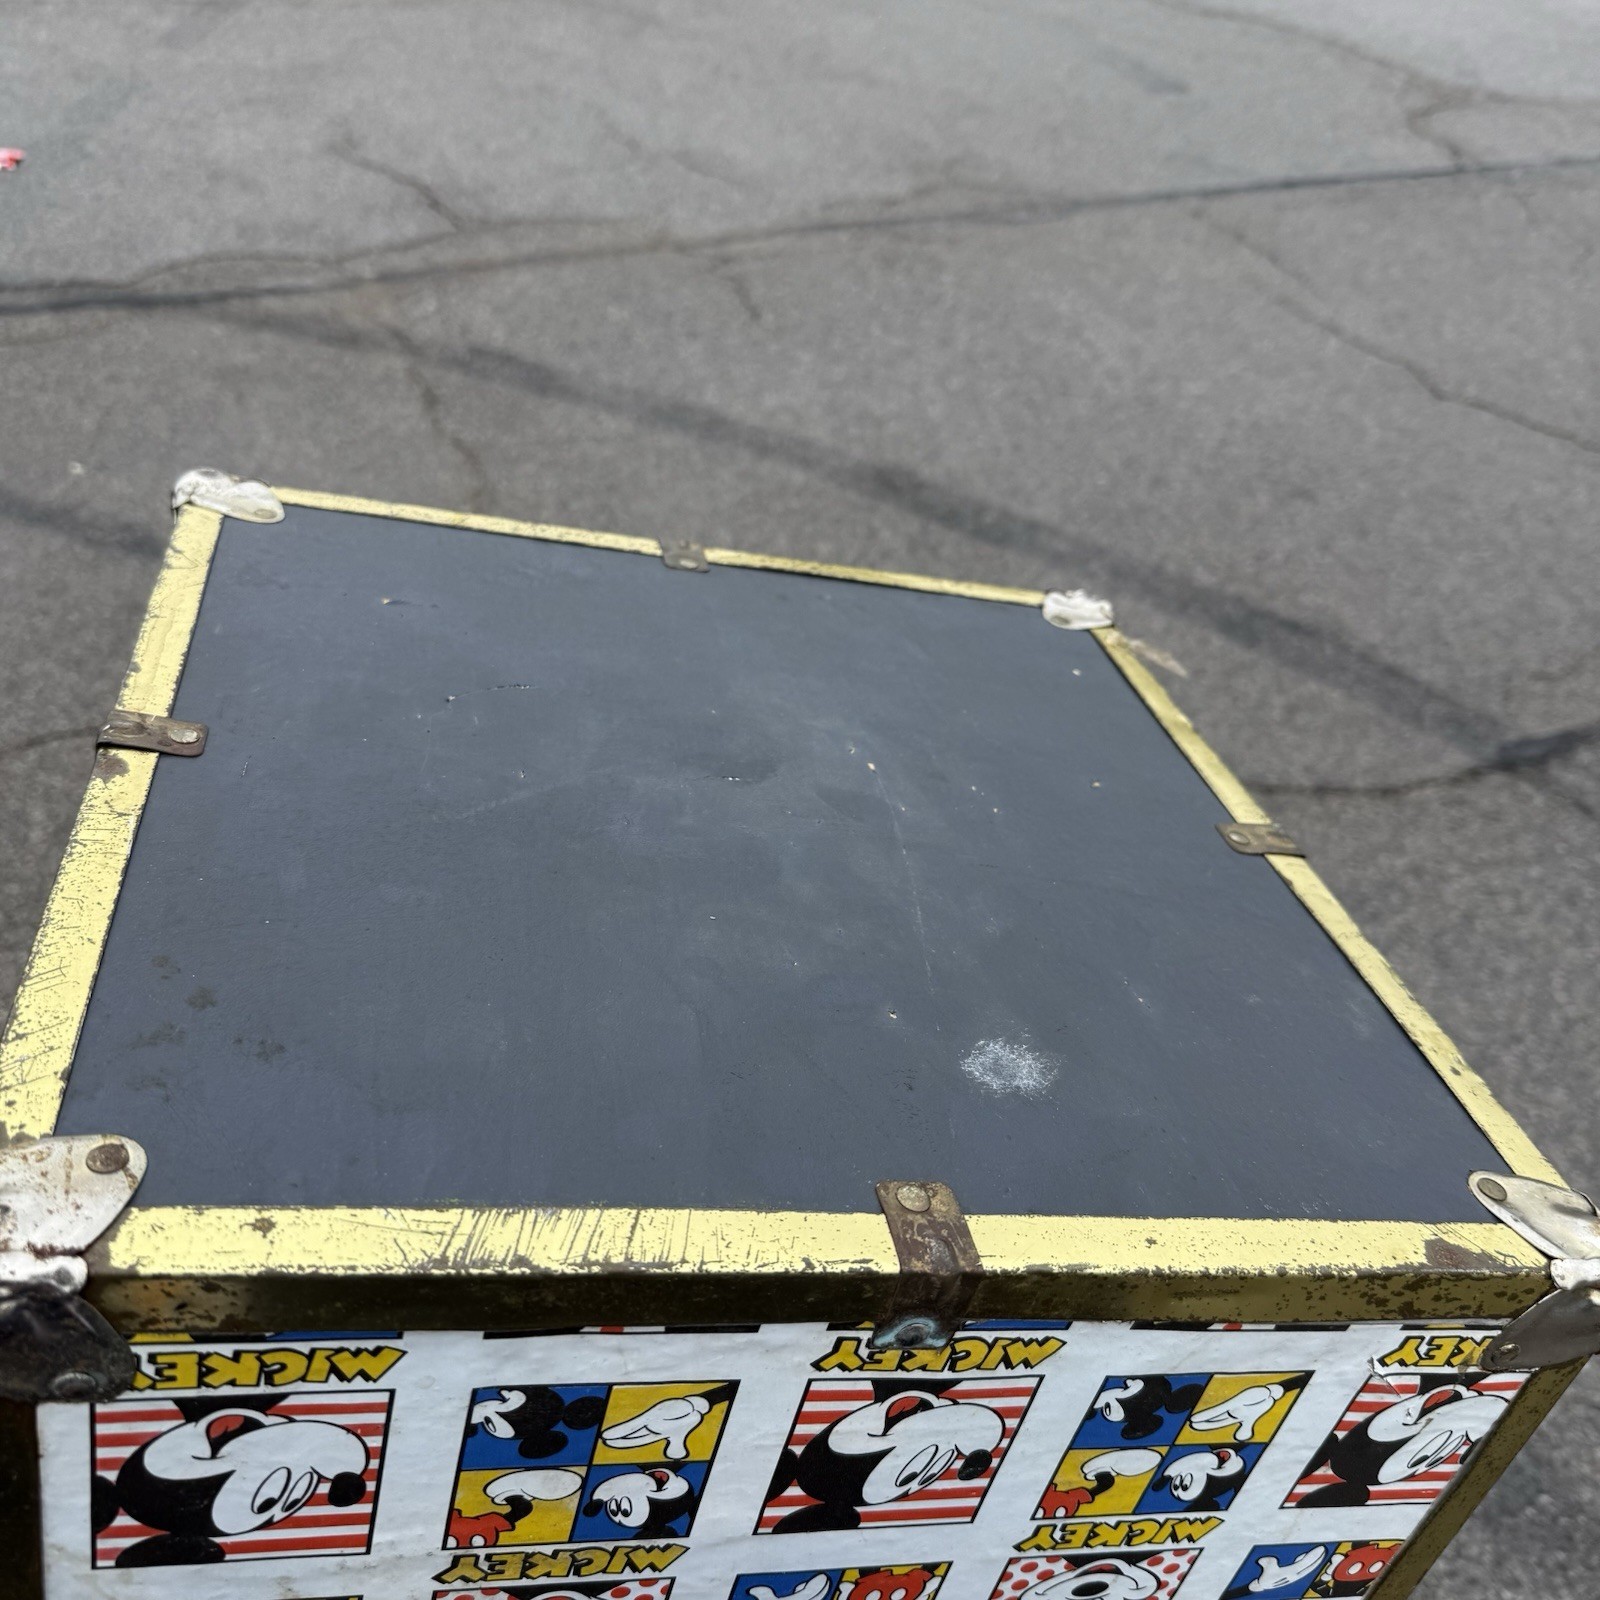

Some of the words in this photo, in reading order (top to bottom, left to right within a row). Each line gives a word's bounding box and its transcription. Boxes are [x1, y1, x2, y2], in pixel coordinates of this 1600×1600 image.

[1376, 1335, 1497, 1368] KEY
[1012, 1516, 1225, 1552] MICKEY
[431, 1543, 690, 1584] MICKEY
